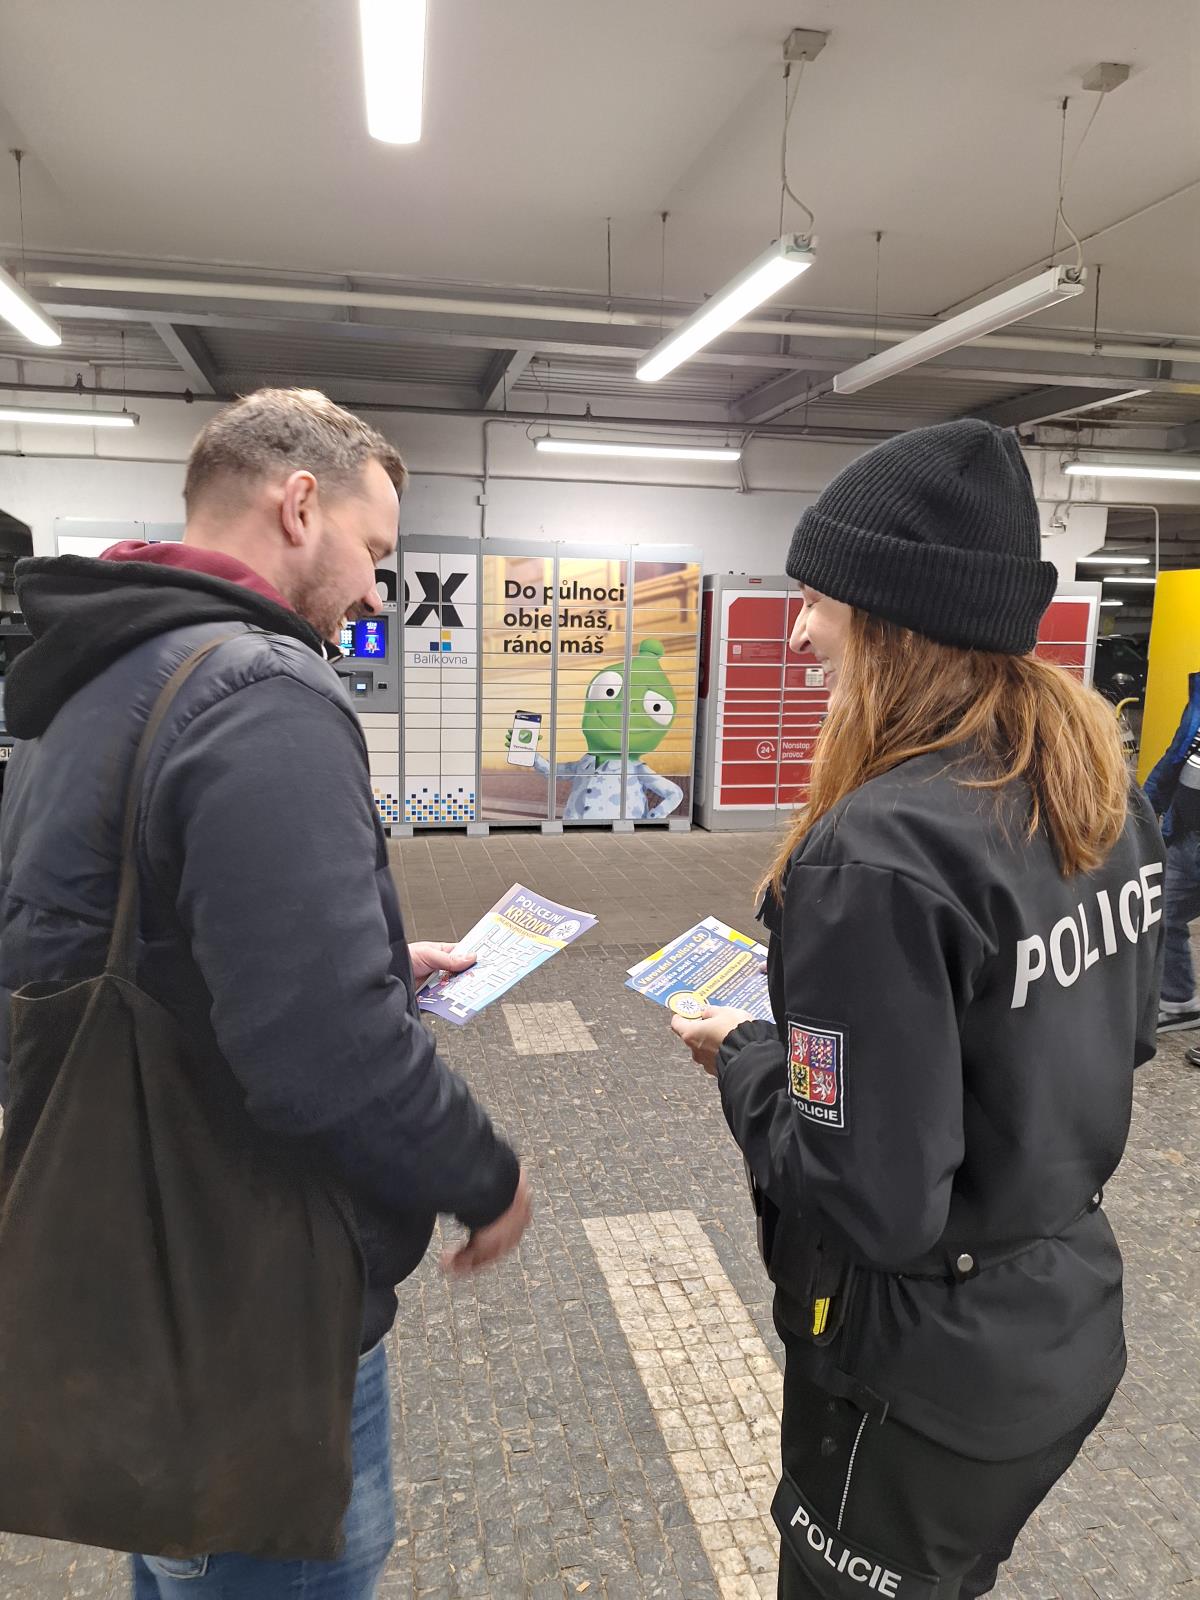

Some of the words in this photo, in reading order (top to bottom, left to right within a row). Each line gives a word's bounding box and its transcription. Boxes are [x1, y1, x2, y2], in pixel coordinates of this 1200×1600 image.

[504, 579, 537, 600] Do
[543, 579, 625, 606] půlnoci
[503, 608, 613, 631] objednáš,
[503, 634, 552, 654] ráno
[559, 635, 605, 654] máš
[413, 653, 468, 665] Balíkovna
[760, 746, 770, 754] 24
[782, 742, 810, 751] Nonstop
[503, 903, 556, 936] KŘÍŽOVKY
[515, 895, 566, 924] POLICEJNÍ
[790, 1505, 902, 1599] POLICIE
